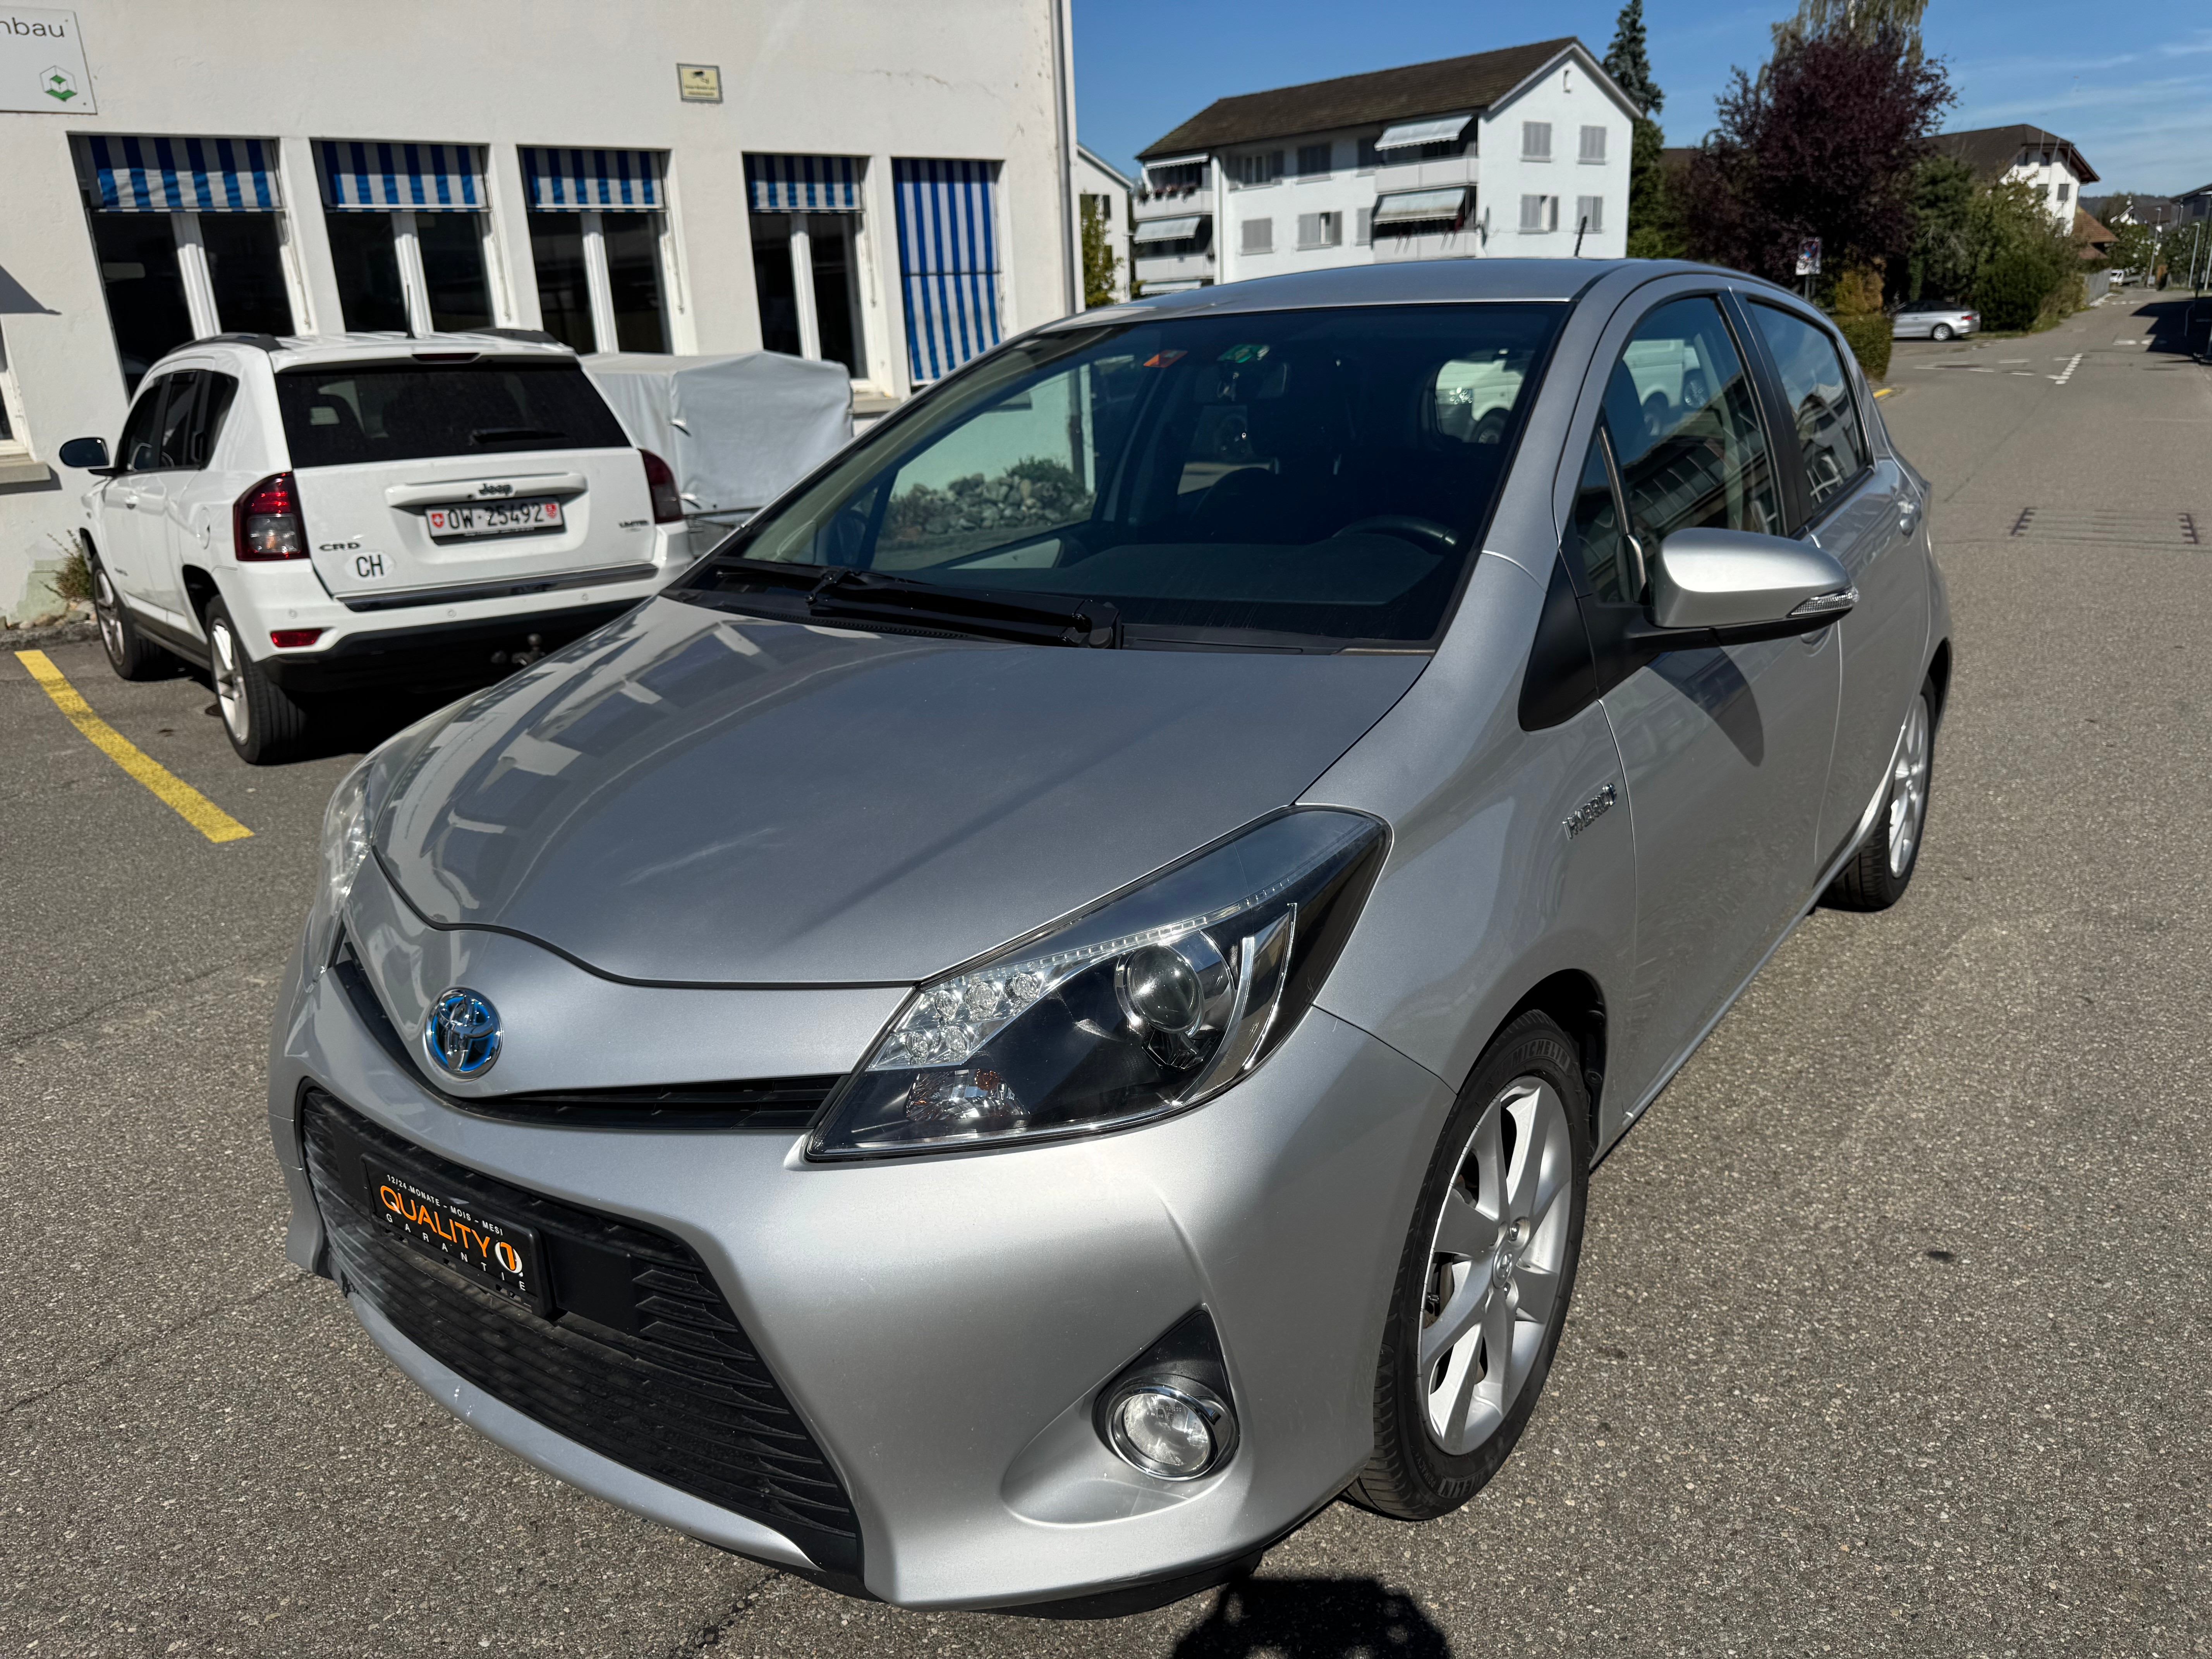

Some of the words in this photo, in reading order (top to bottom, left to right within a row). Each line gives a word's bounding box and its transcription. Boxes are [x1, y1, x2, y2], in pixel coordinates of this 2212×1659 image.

[478, 483, 513, 496] Jeep
[448, 508, 474, 529] OW
[485, 503, 544, 526] 25492
[319, 542, 361, 551] CRD
[356, 554, 384, 577] CH
[1512, 1040, 1568, 1068] MICHELIN
[380, 1185, 490, 1258] QUALITY
[409, 1185, 440, 1206] MONATE
[450, 1206, 471, 1221] MOIS
[482, 1220, 503, 1236] MESI
[386, 1213, 526, 1291] GARANTIE
